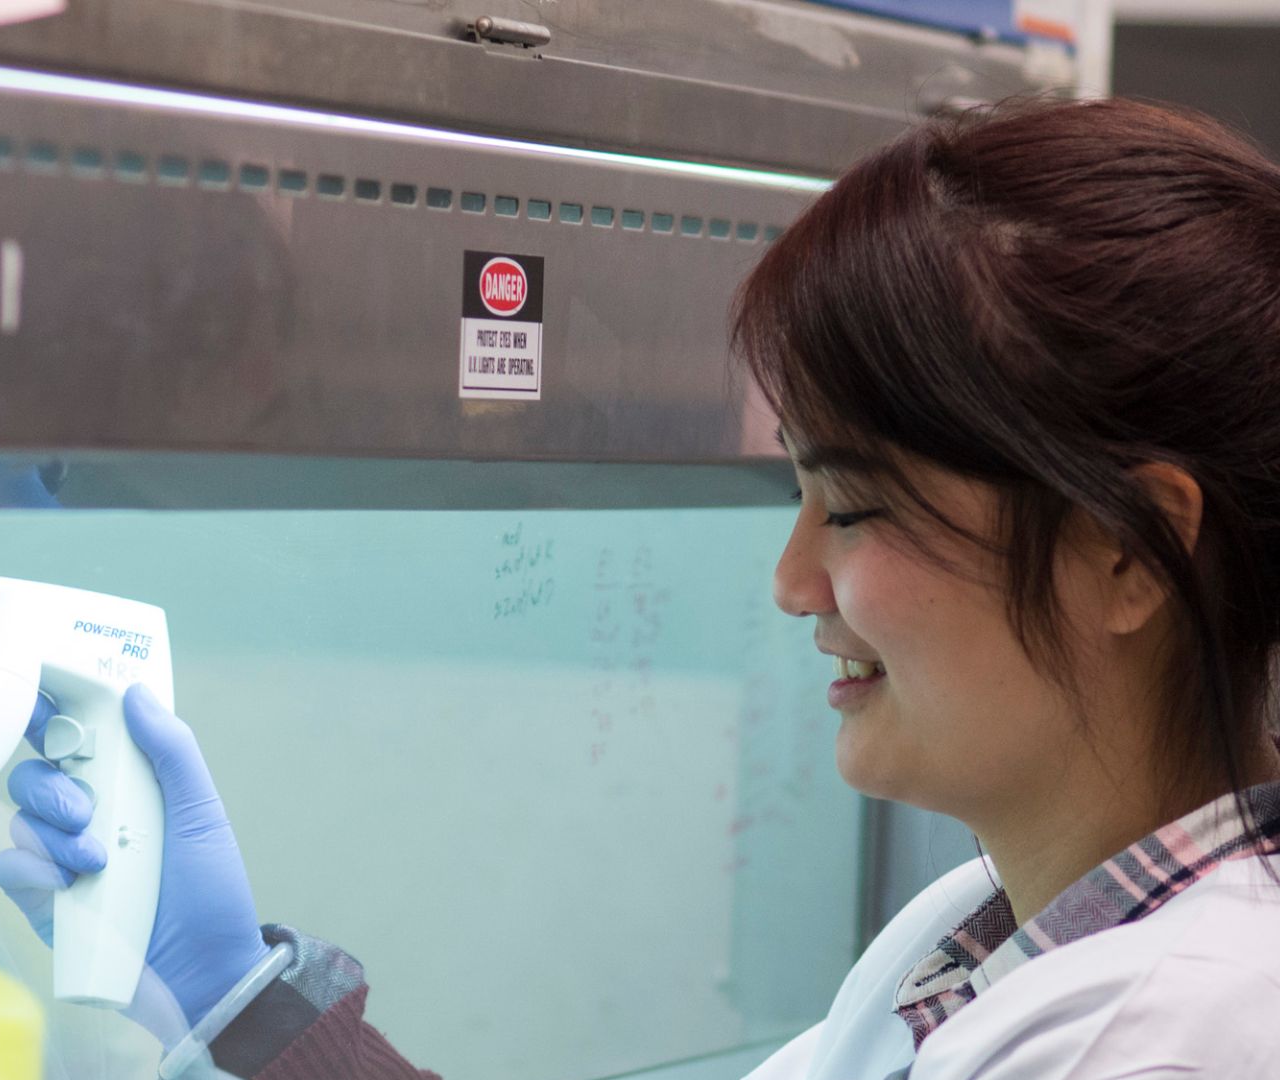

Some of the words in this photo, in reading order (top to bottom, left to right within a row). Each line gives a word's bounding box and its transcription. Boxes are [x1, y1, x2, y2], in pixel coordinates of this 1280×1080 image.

[485, 272, 523, 302] DANGER
[477, 329, 498, 348] PROTECT
[500, 331, 511, 349] EYES
[513, 332, 527, 349] WHEN
[479, 356, 495, 375] LIGHTS
[497, 357, 506, 375] ARE
[73, 620, 153, 647] POWERPETTE
[122, 643, 149, 660] PRO
